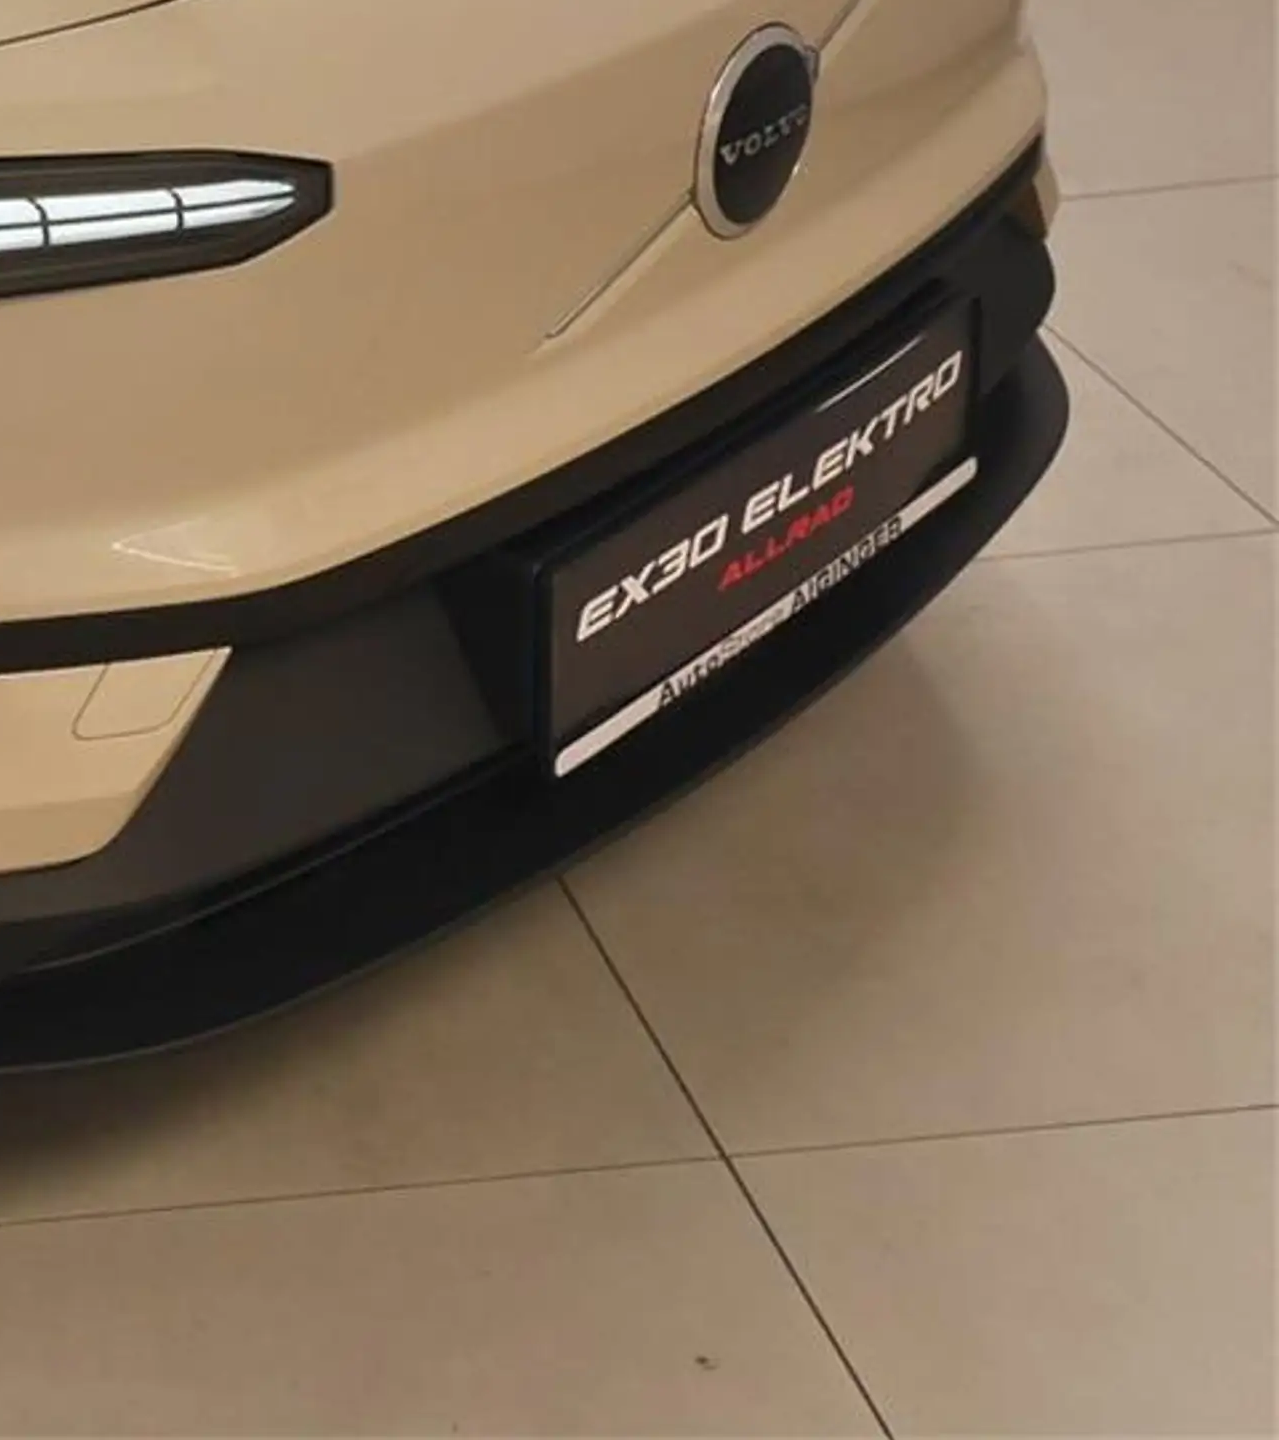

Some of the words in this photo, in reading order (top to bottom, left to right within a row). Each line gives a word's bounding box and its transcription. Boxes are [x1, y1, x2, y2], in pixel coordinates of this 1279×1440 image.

[720, 104, 808, 166] VOLVO
[576, 513, 729, 643] EX30
[741, 350, 963, 534] ELEKTRO
[717, 485, 854, 593] ALLRAD
